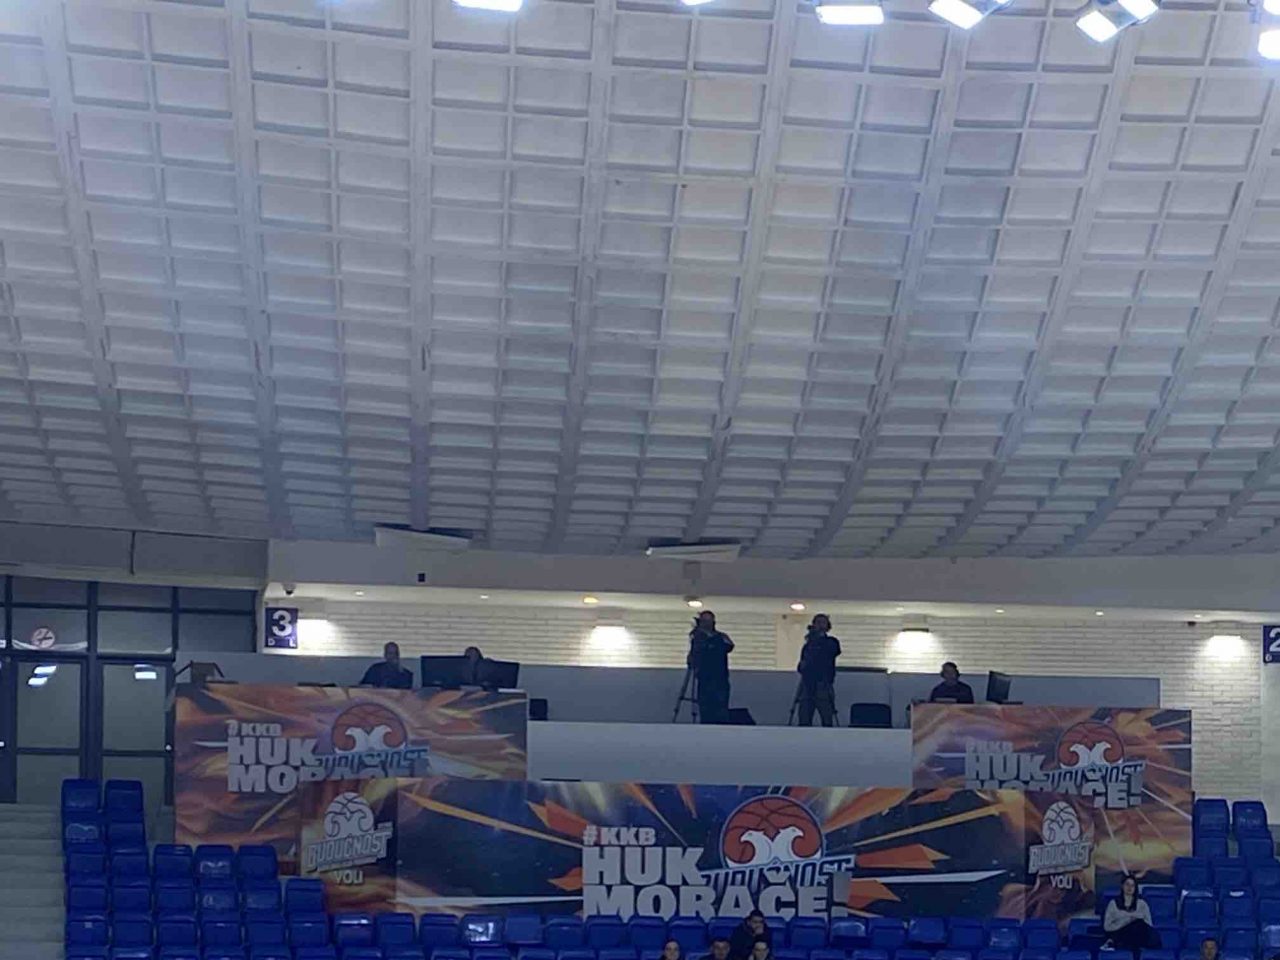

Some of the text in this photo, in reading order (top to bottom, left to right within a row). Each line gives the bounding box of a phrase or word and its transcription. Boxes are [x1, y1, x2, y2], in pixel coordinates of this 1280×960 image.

[272, 610, 293, 637] 3
[228, 737, 318, 766] HUK
[966, 752, 1046, 781] HUK
[582, 825, 656, 845] #KKB
[582, 847, 704, 885] HUK
